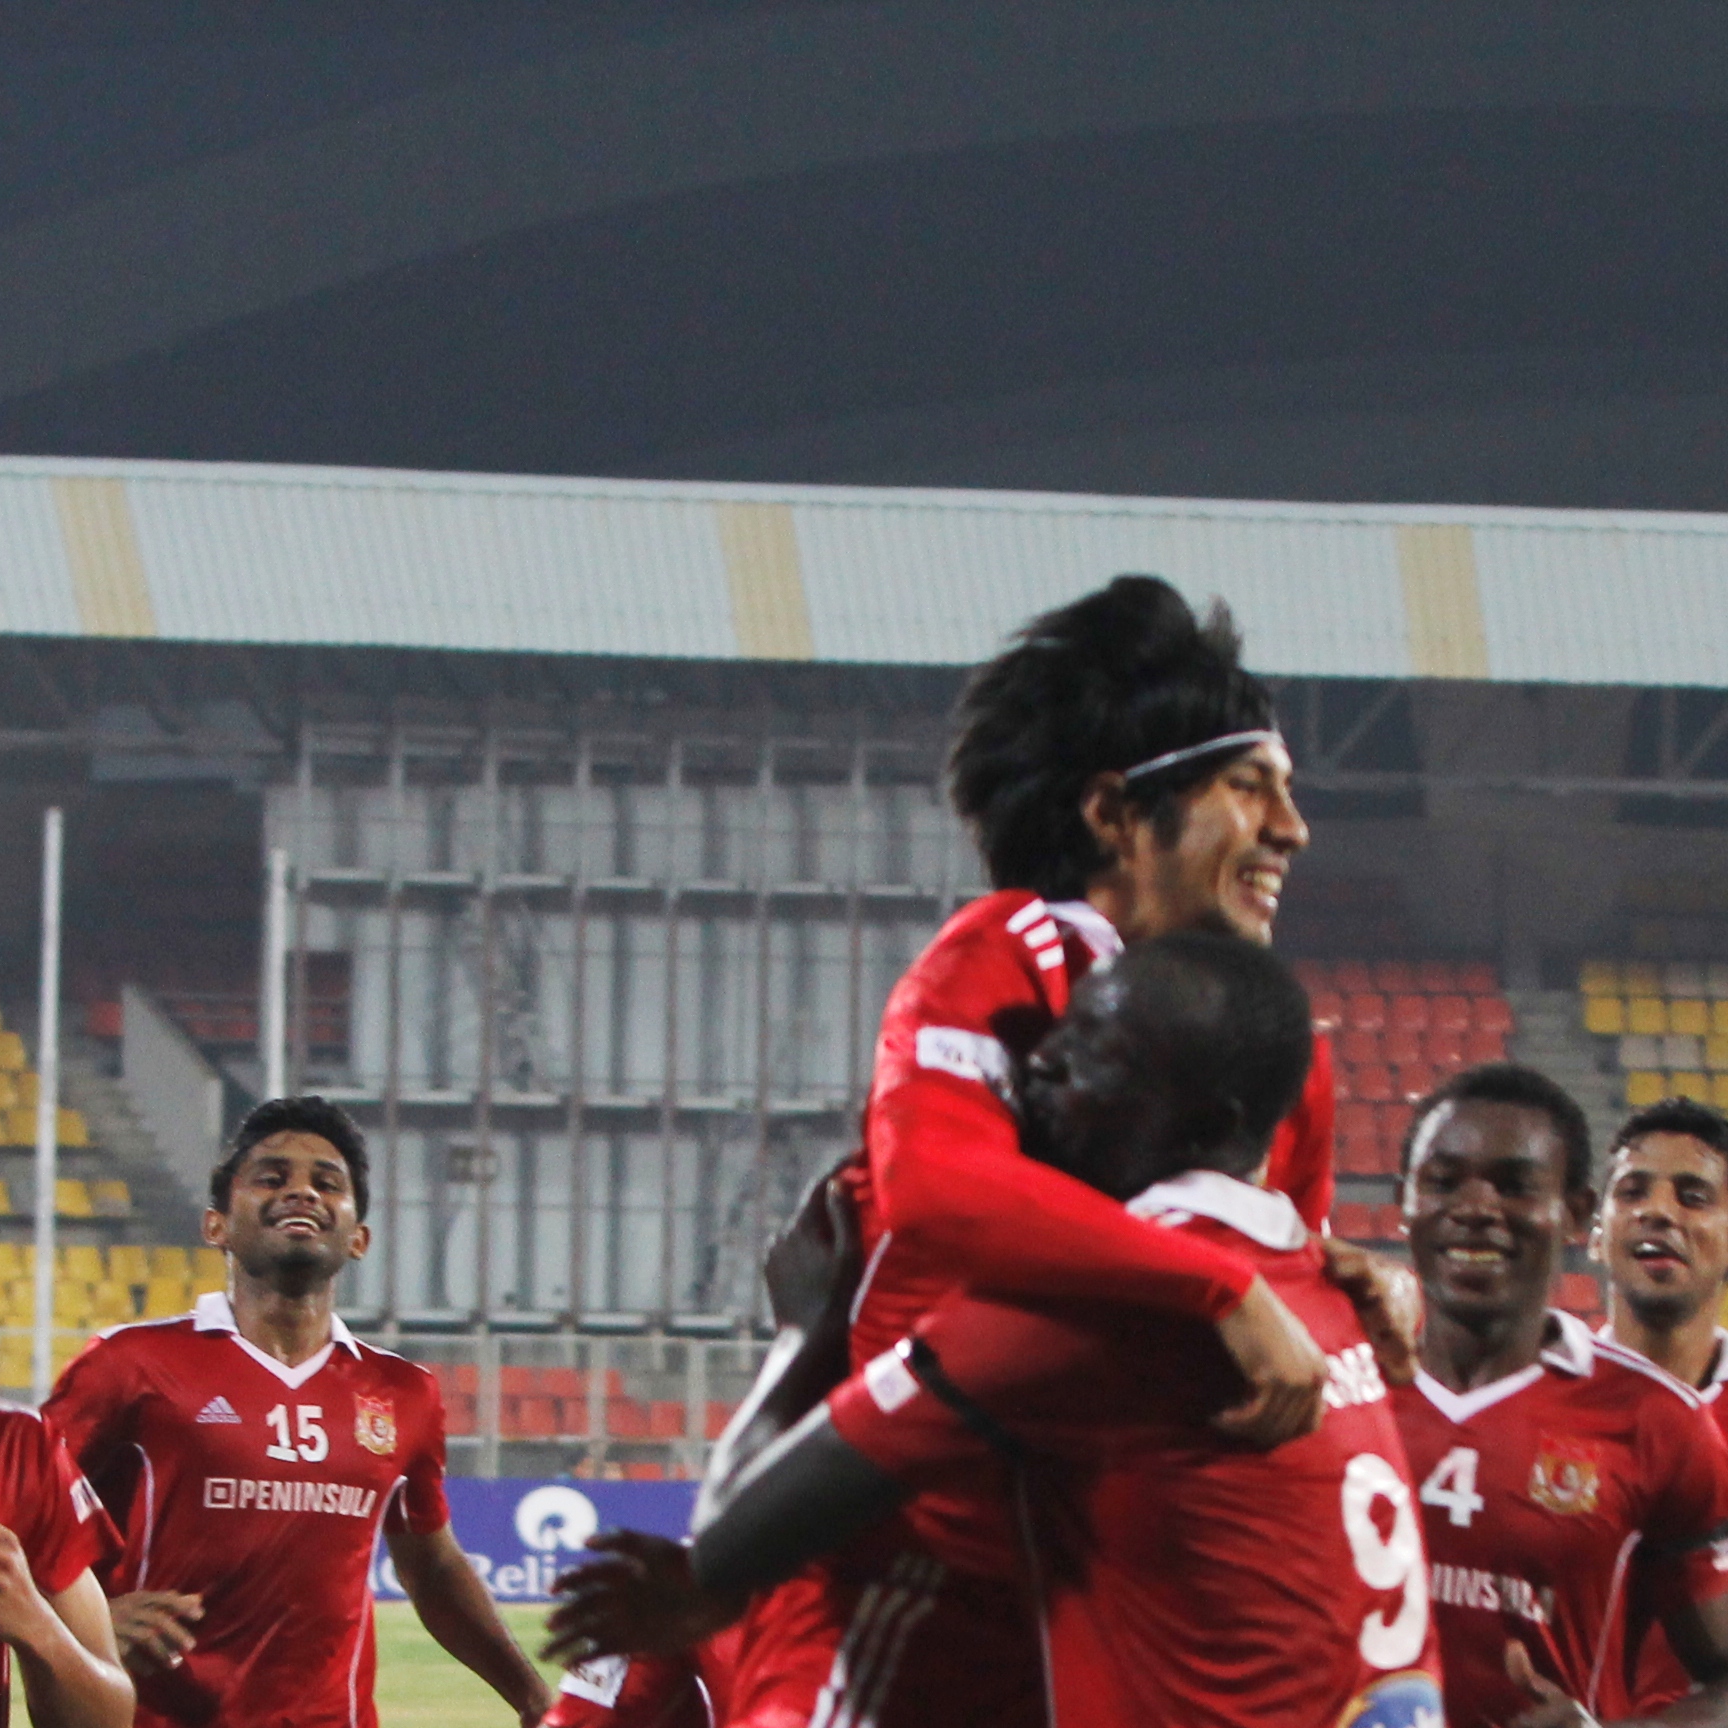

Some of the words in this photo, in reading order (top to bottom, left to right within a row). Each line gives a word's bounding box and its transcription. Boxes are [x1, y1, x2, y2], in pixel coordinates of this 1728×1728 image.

[266, 1403, 330, 1462] 15
[1419, 1446, 1484, 1528] 4
[464, 1551, 580, 1598] Reli
[1341, 1452, 1428, 1669] 9
